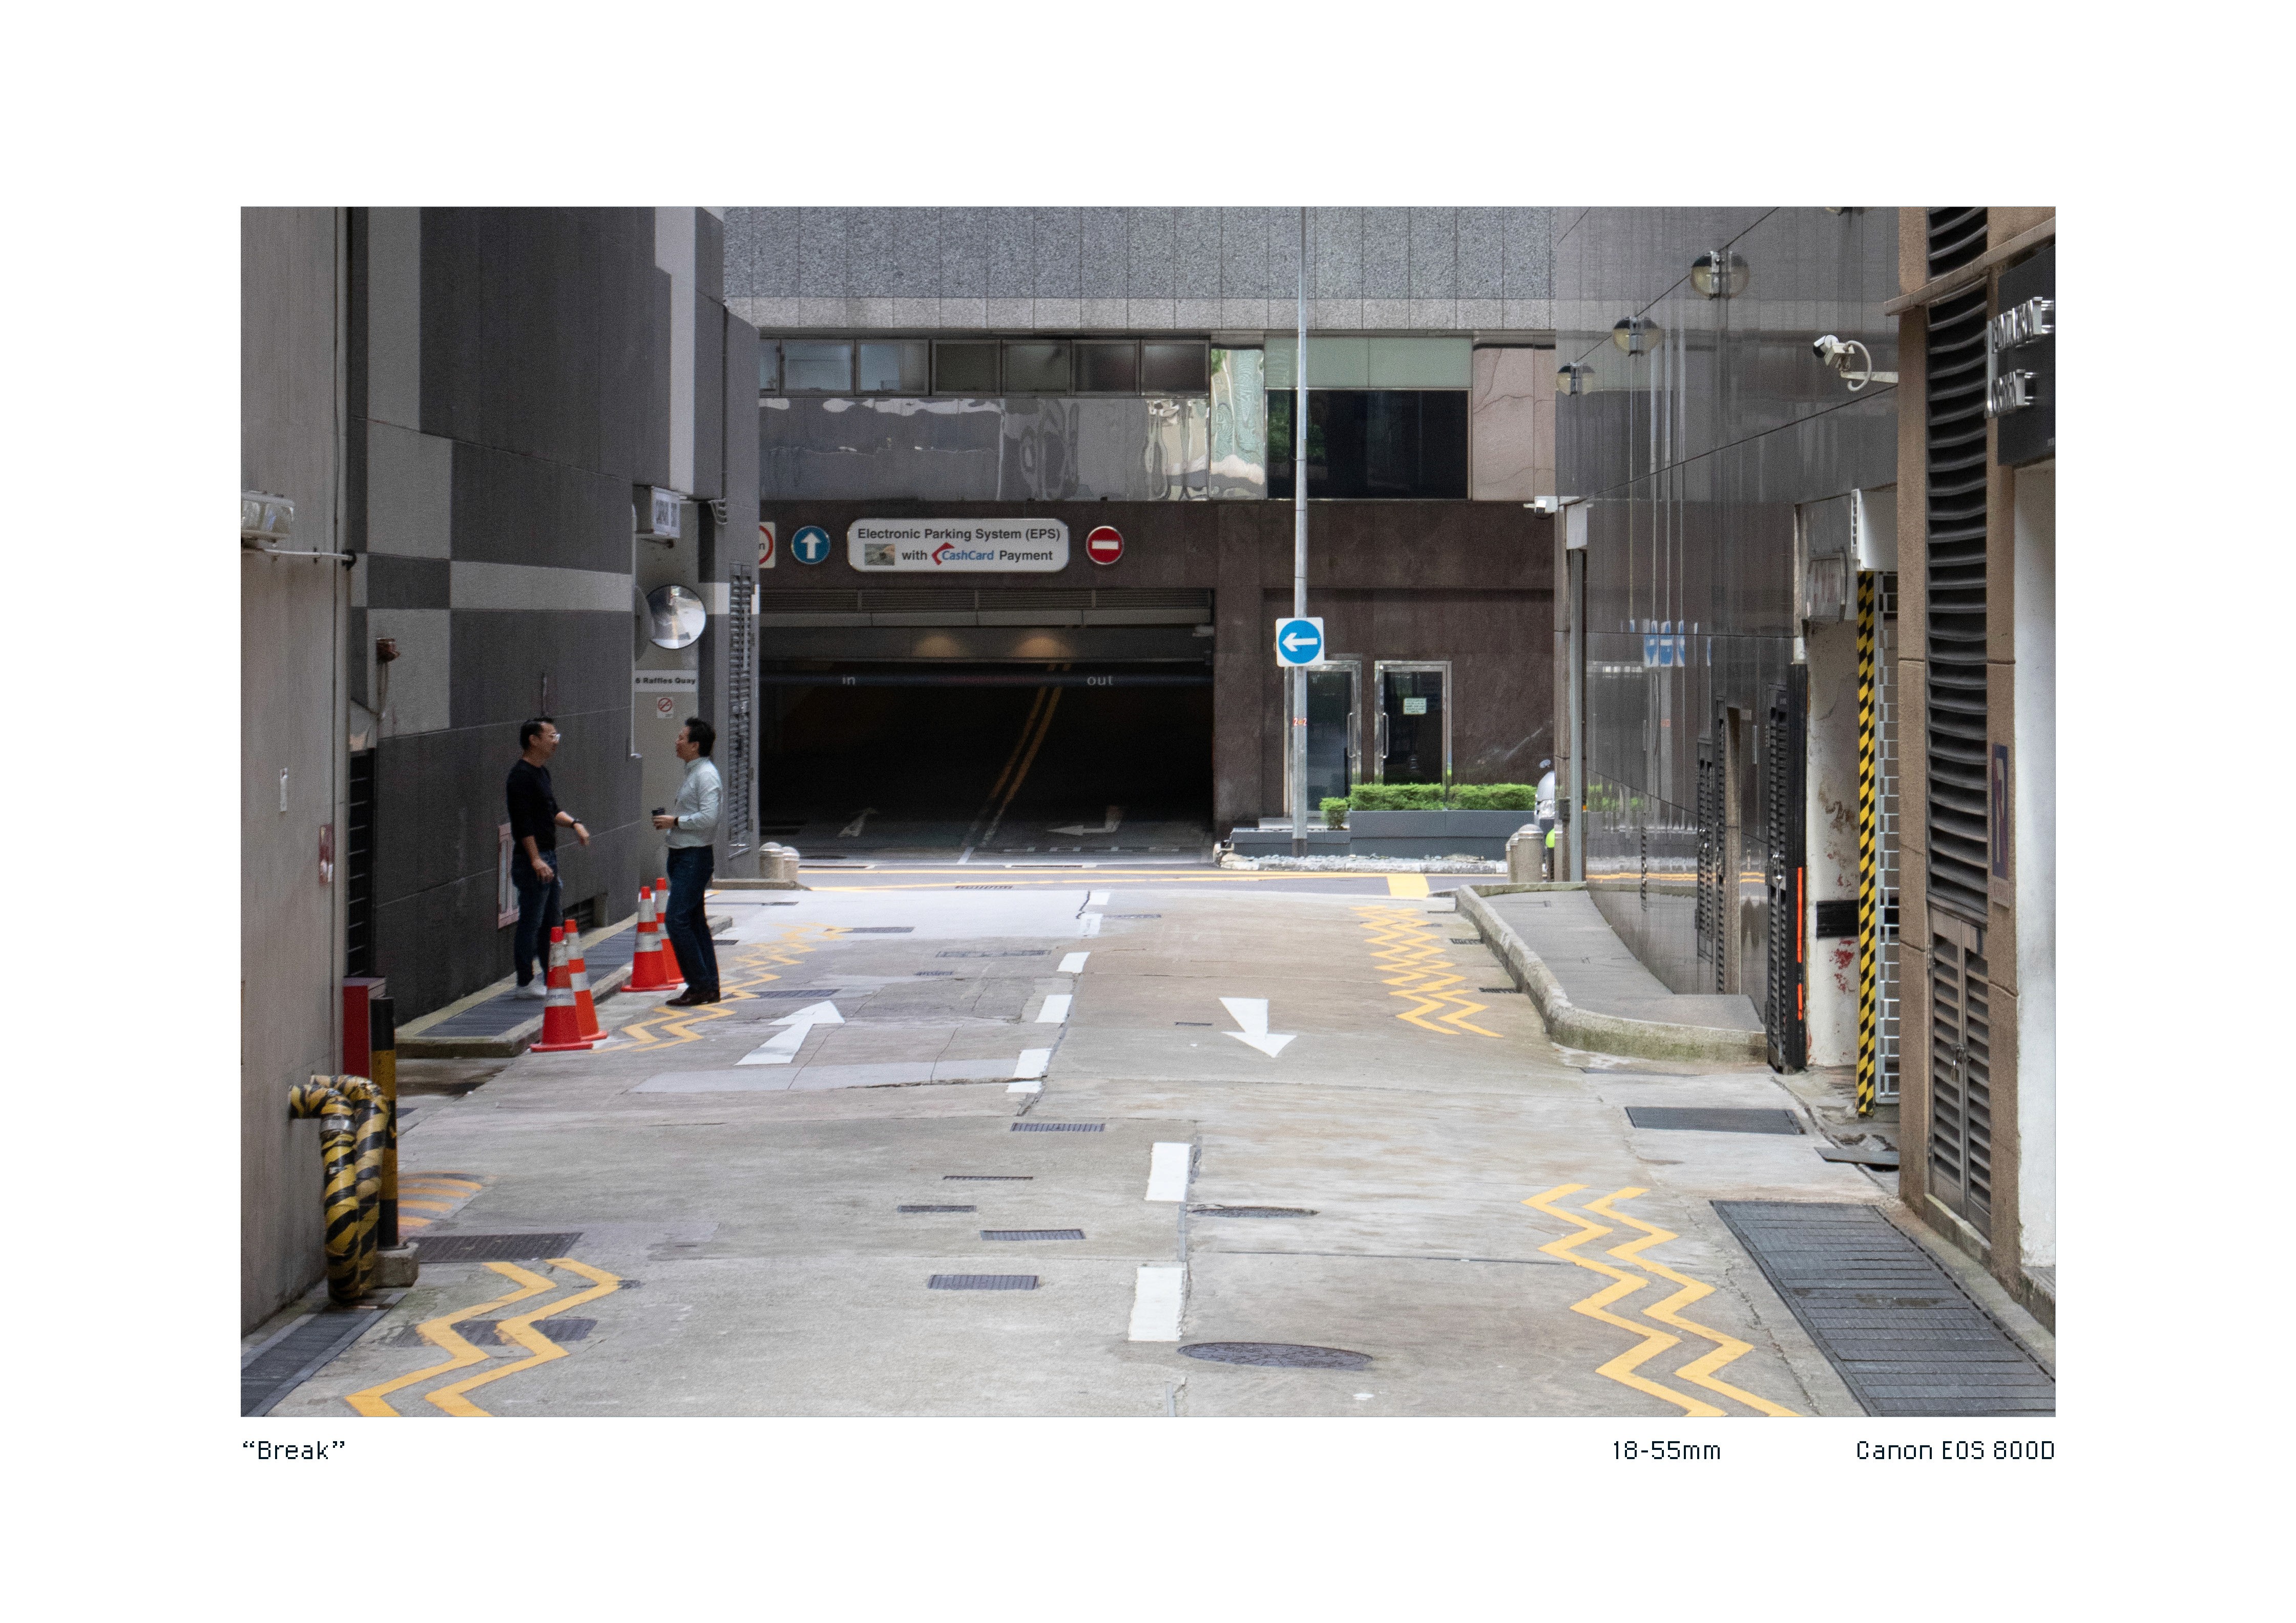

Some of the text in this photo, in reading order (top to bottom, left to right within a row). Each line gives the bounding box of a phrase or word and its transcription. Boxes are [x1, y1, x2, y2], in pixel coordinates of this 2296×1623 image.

[858, 529, 1060, 542] Electronic Parking System (EPS)
[902, 550, 1053, 563] with CashCard Payment
[675, 677, 696, 685] Quay
[842, 675, 855, 685] in
[1087, 675, 1114, 686] out
